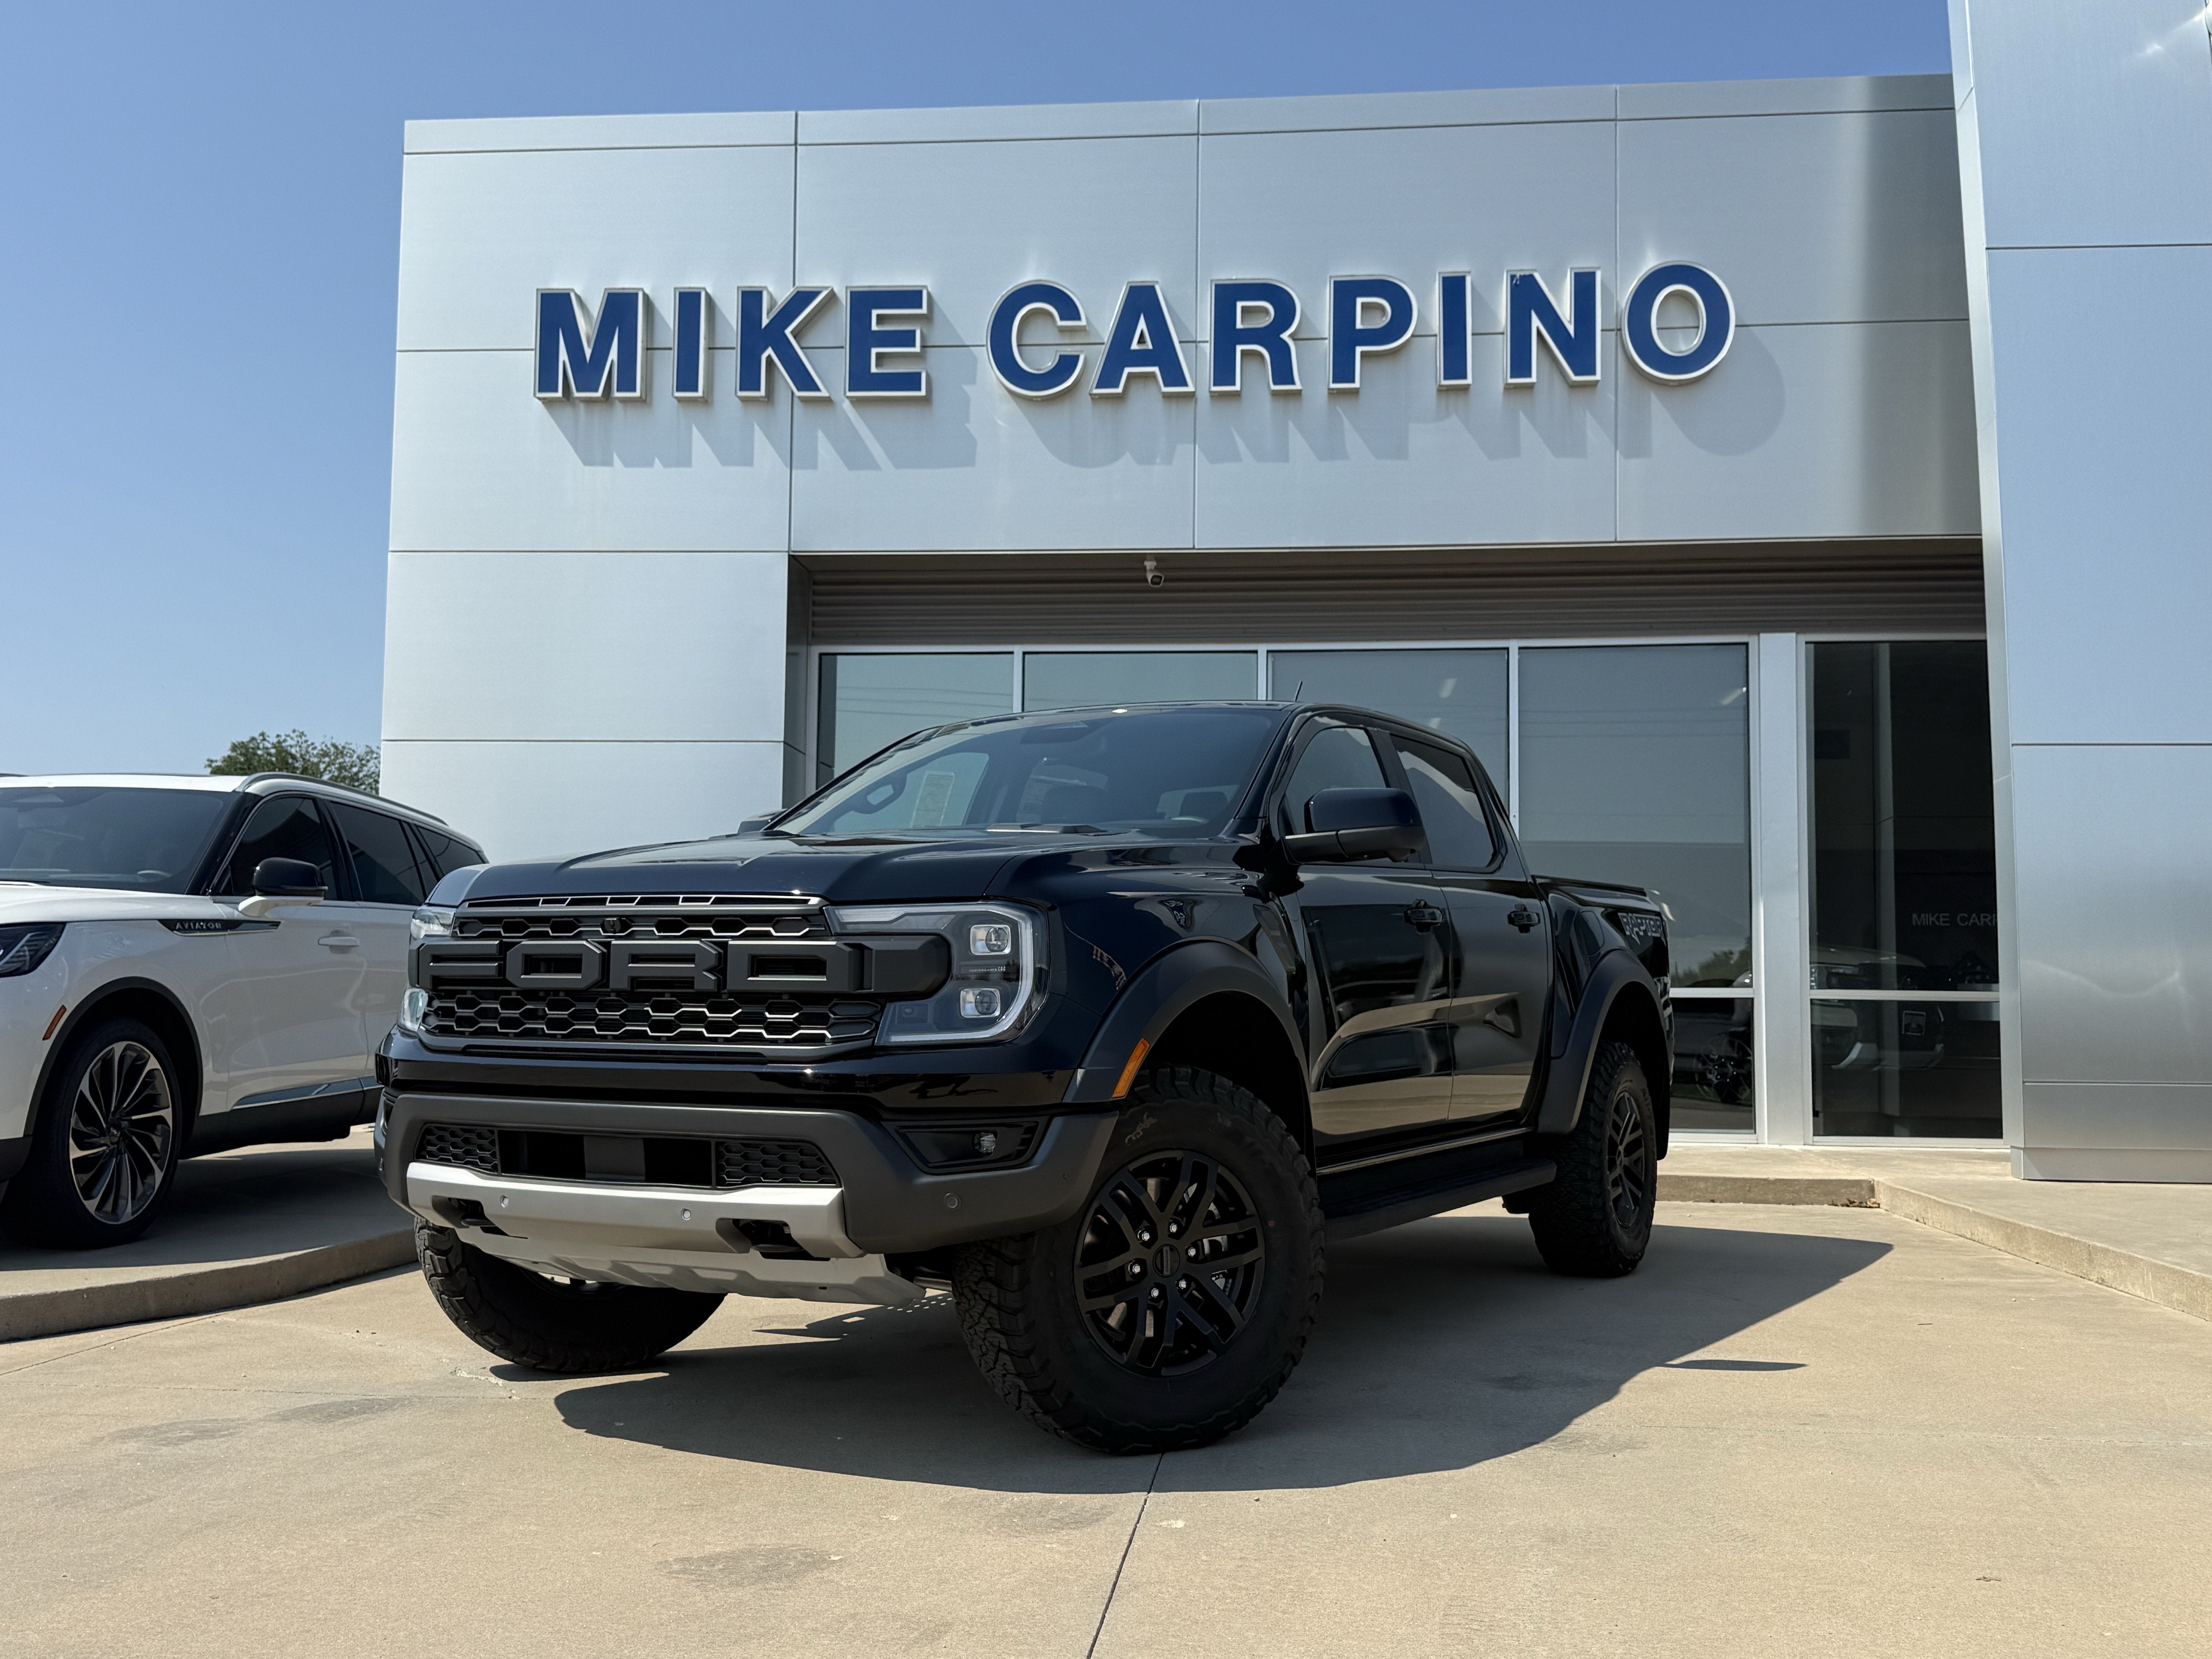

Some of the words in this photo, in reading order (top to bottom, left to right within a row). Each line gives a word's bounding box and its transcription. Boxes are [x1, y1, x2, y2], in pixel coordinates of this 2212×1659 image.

[535, 286, 930, 400] MIKE
[987, 263, 1736, 399] CARPINO
[1618, 912, 1662, 945] RAPTOR
[1912, 913, 1950, 926] MIKE
[1957, 913, 1996, 926] CAR
[418, 937, 857, 992] FORD
